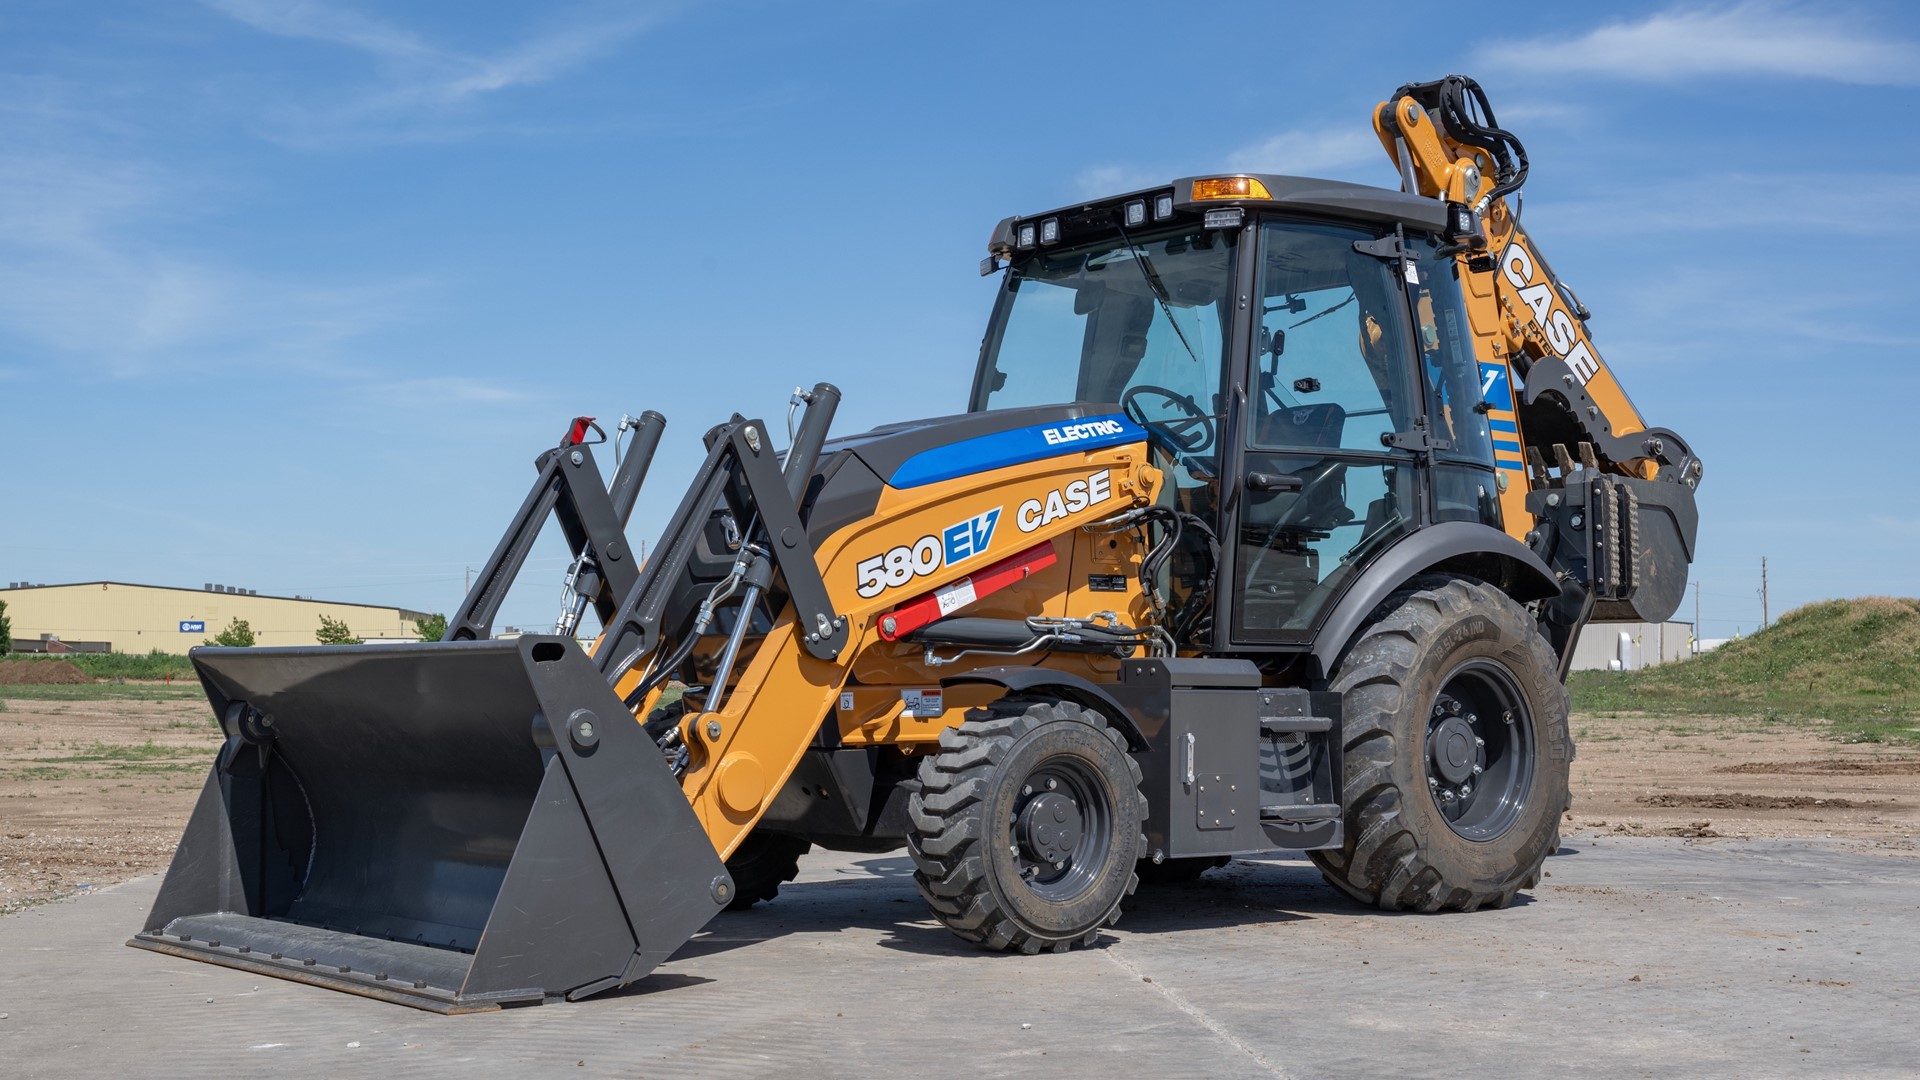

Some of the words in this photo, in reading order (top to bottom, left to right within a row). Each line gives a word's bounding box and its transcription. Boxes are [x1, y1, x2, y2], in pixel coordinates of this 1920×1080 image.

[1502, 242, 1600, 387] CASE
[1042, 419, 1124, 445] ELECTRIC
[1016, 468, 1111, 533] CASE
